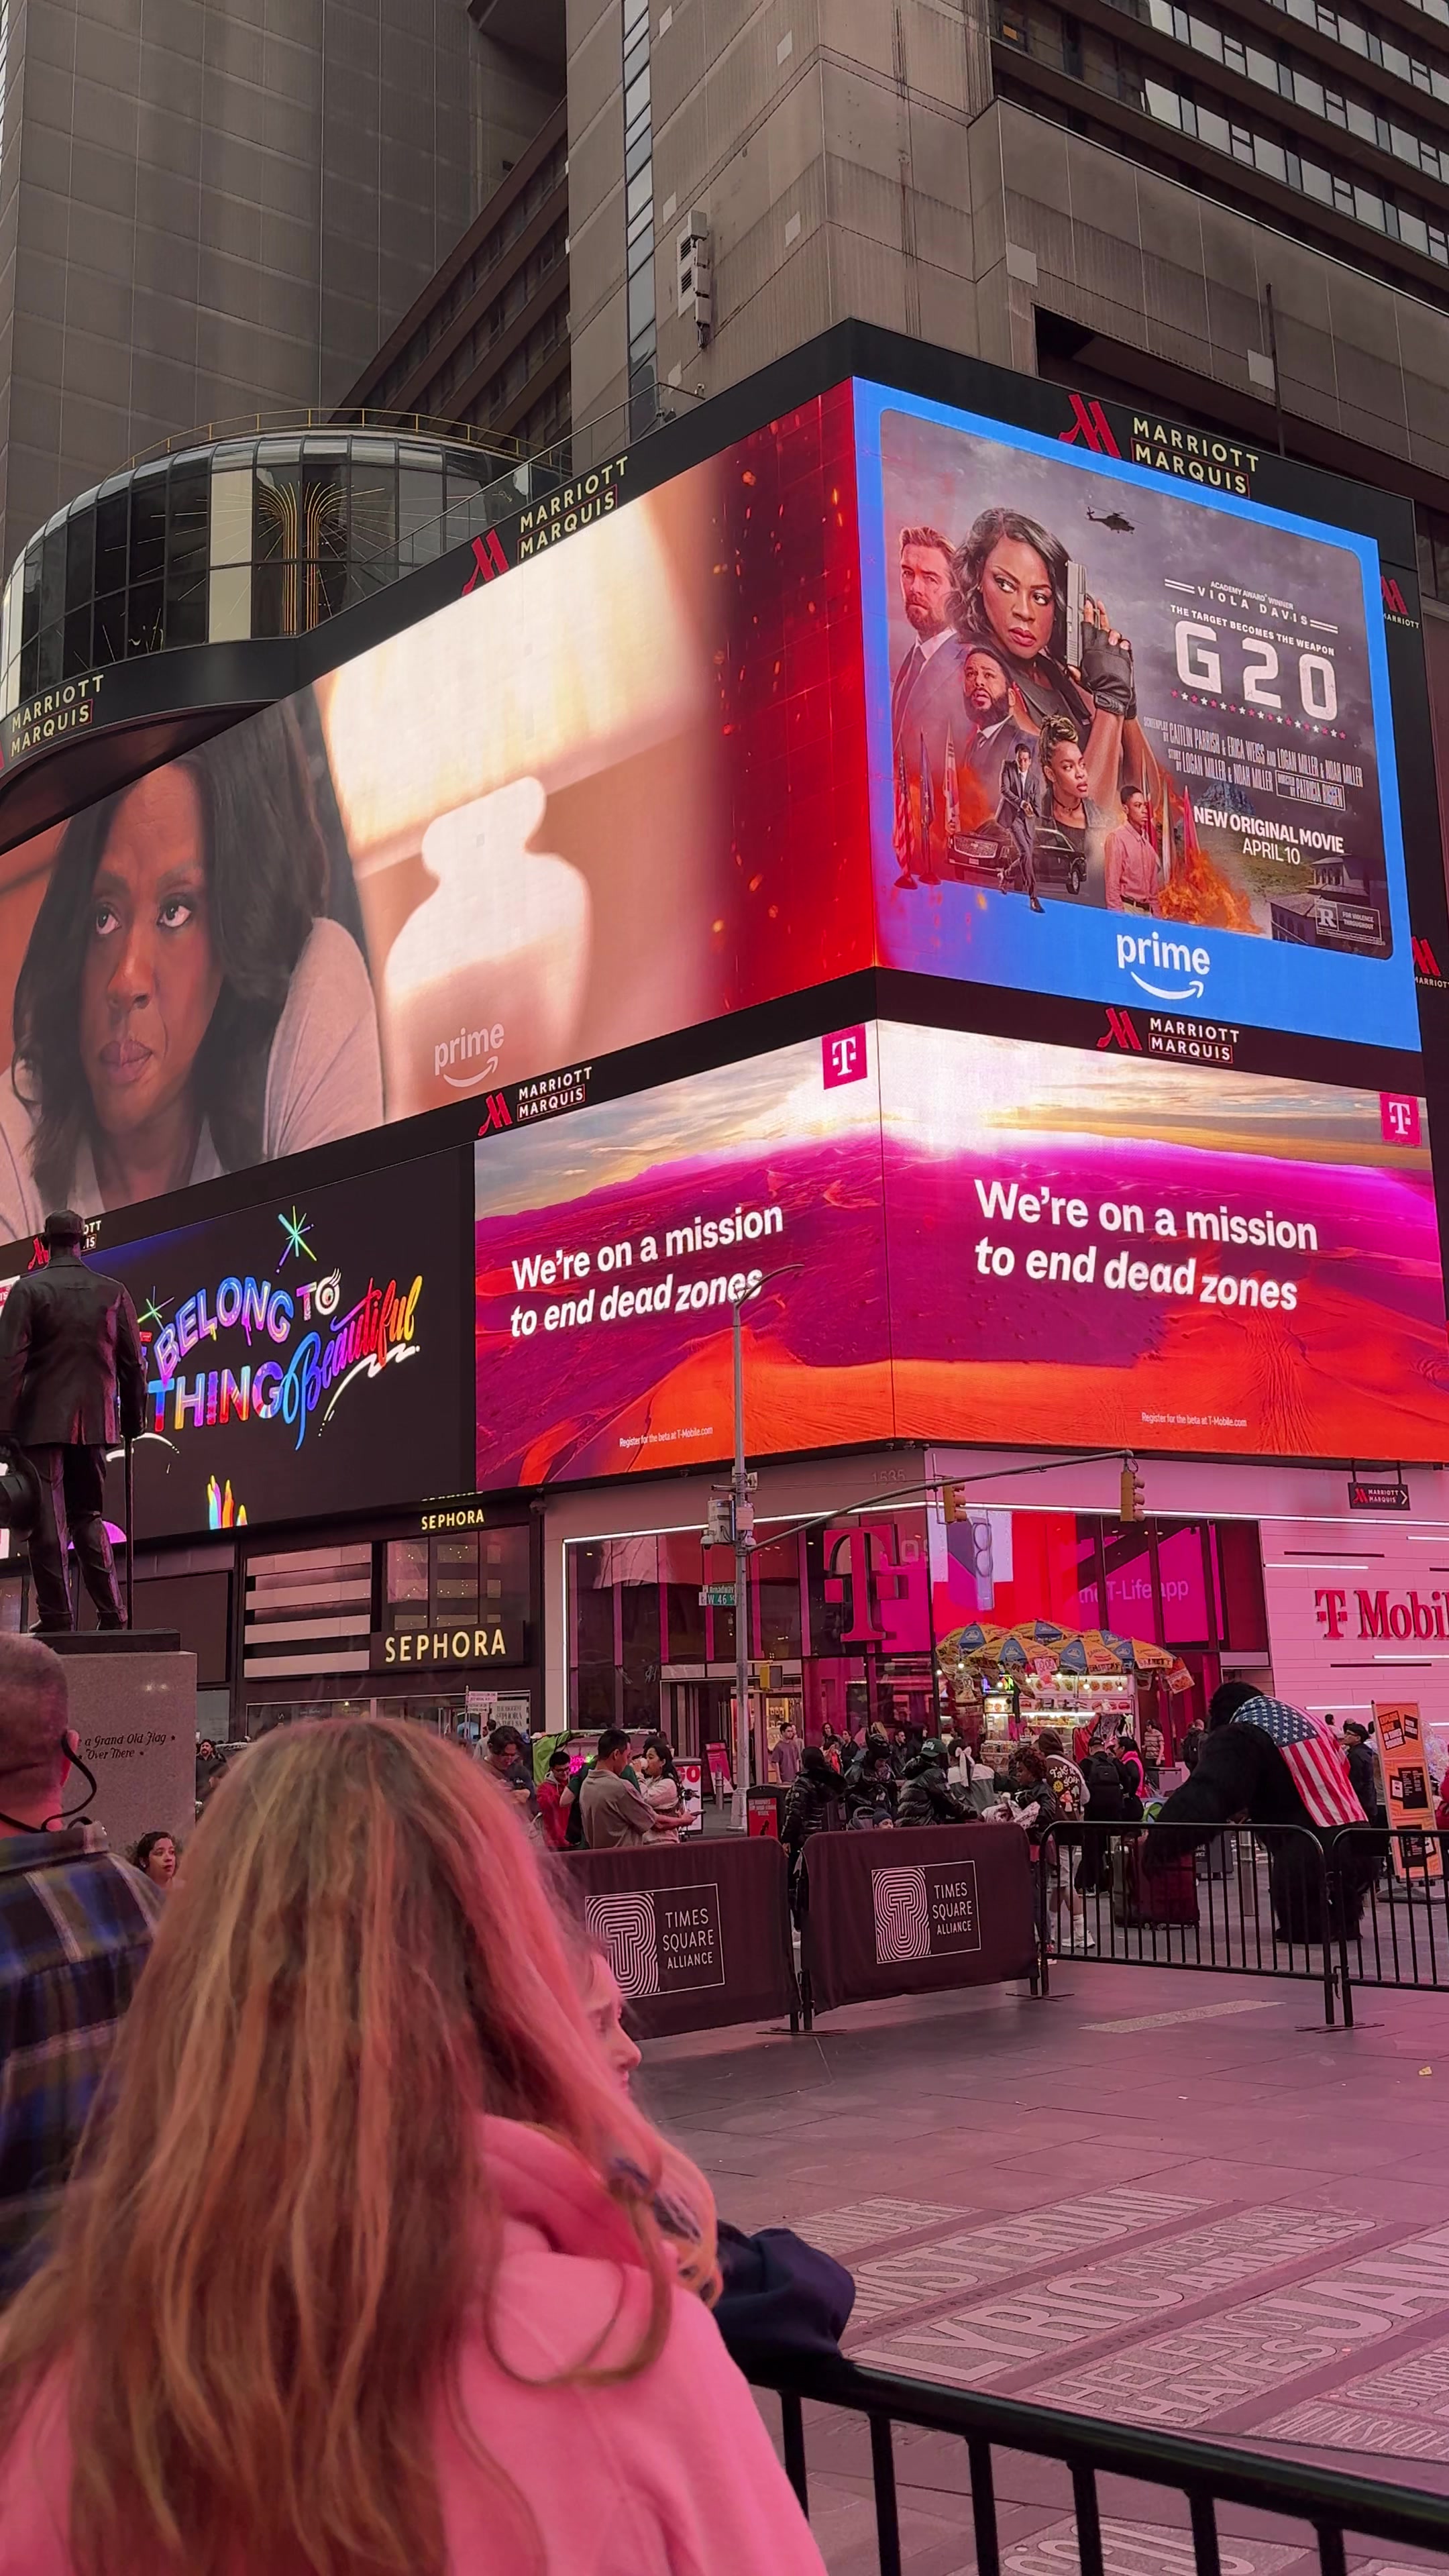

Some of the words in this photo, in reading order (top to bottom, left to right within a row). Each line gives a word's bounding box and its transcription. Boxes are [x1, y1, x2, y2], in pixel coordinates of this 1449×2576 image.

[1133, 417, 1259, 472] MARRIOTT
[1135, 443, 1247, 494] MARQUIS
[520, 455, 628, 533] MARRIOTT
[520, 490, 615, 559] MARQUIS
[1197, 586, 1250, 610] VIOLA
[1259, 604, 1308, 625] DAVIS
[1210, 581, 1242, 596] ACADEMY
[1268, 596, 1293, 610] WINNER
[1170, 604, 1189, 616] THE
[1191, 610, 1228, 627] TARGET
[1230, 618, 1274, 639] BECOMES
[1276, 633, 1294, 645] THE
[1296, 638, 1334, 656] WEAPON
[11, 674, 105, 733] MARRIOTT
[11, 704, 89, 757] MARQUIS
[1169, 722, 1193, 748] CAITLIN
[1227, 736, 1245, 760] ERICA
[1245, 740, 1265, 765] WEISS
[1277, 747, 1297, 772] LOGAN
[1297, 752, 1319, 777] MILLER
[1325, 759, 1342, 782] NOAH
[1342, 763, 1364, 788] MILLER
[1182, 751, 1203, 777] LOGAN
[1204, 756, 1227, 782] MILLER
[1233, 763, 1251, 788] NOAH
[1252, 767, 1274, 792] MILLER
[1193, 805, 1228, 829] NEW
[1230, 814, 1299, 845] ORIGINAL
[1300, 828, 1344, 853] MOVIE
[1242, 838, 1284, 862] APRIL
[1285, 846, 1301, 865] 10
[1317, 907, 1337, 928] R
[1116, 931, 1210, 975] prime
[435, 1023, 504, 1077] prime
[1150, 1018, 1240, 1043] MARRIOTT
[1151, 1036, 1230, 1061] MARQUIS
[519, 1067, 592, 1101] MARRIOTT
[519, 1087, 584, 1119] MARQUIS
[596, 1240, 632, 1273] on
[639, 1235, 658, 1263] a
[665, 1206, 784, 1257] mission
[1098, 1201, 1144, 1234] on
[1155, 1208, 1177, 1237] a
[1186, 1205, 1318, 1252] mission
[975, 1236, 1016, 1277] to
[1025, 1246, 1097, 1284] end
[1103, 1250, 1197, 1296] dead
[1198, 1273, 1298, 1311] zones
[510, 1305, 537, 1338] to
[544, 1289, 596, 1332] end
[599, 1273, 674, 1322] dead
[674, 1268, 763, 1314] zones
[153, 1276, 295, 1388] BELONG
[296, 1268, 343, 1322] TO
[619, 1437, 641, 1448] Register
[641, 1434, 649, 1444] for
[649, 1433, 658, 1443] the
[658, 1432, 671, 1442] beta
[670, 1430, 677, 1440] at
[421, 1509, 484, 1530] SEPHORA
[708, 1594, 714, 1605] W
[717, 1594, 727, 1605] 46
[1107, 1578, 1152, 1601] T-Life
[385, 1629, 506, 1663] SEPHORA
[86, 1748, 108, 1760] Over
[110, 1747, 135, 1759] There
[95, 1735, 124, 1748] Grand
[127, 1732, 144, 1745] Old
[1049, 1764, 1068, 1778] Take
[932, 1900, 973, 1921] SQUARE
[934, 1882, 967, 1899] TIMES
[665, 1908, 708, 1929] TIMES
[936, 1920, 971, 1935] ALLIANCE
[662, 1929, 714, 1952] SQUARE
[667, 1951, 713, 1970] ALLIANCE
[1104, 2206, 1320, 2279] AMERICAN
[1163, 2216, 1376, 2290] AIRLINES
[849, 2277, 1184, 2382] LYRIC
[1034, 2324, 1271, 2409] HELEN
[1114, 2339, 1337, 2423] HAYES
